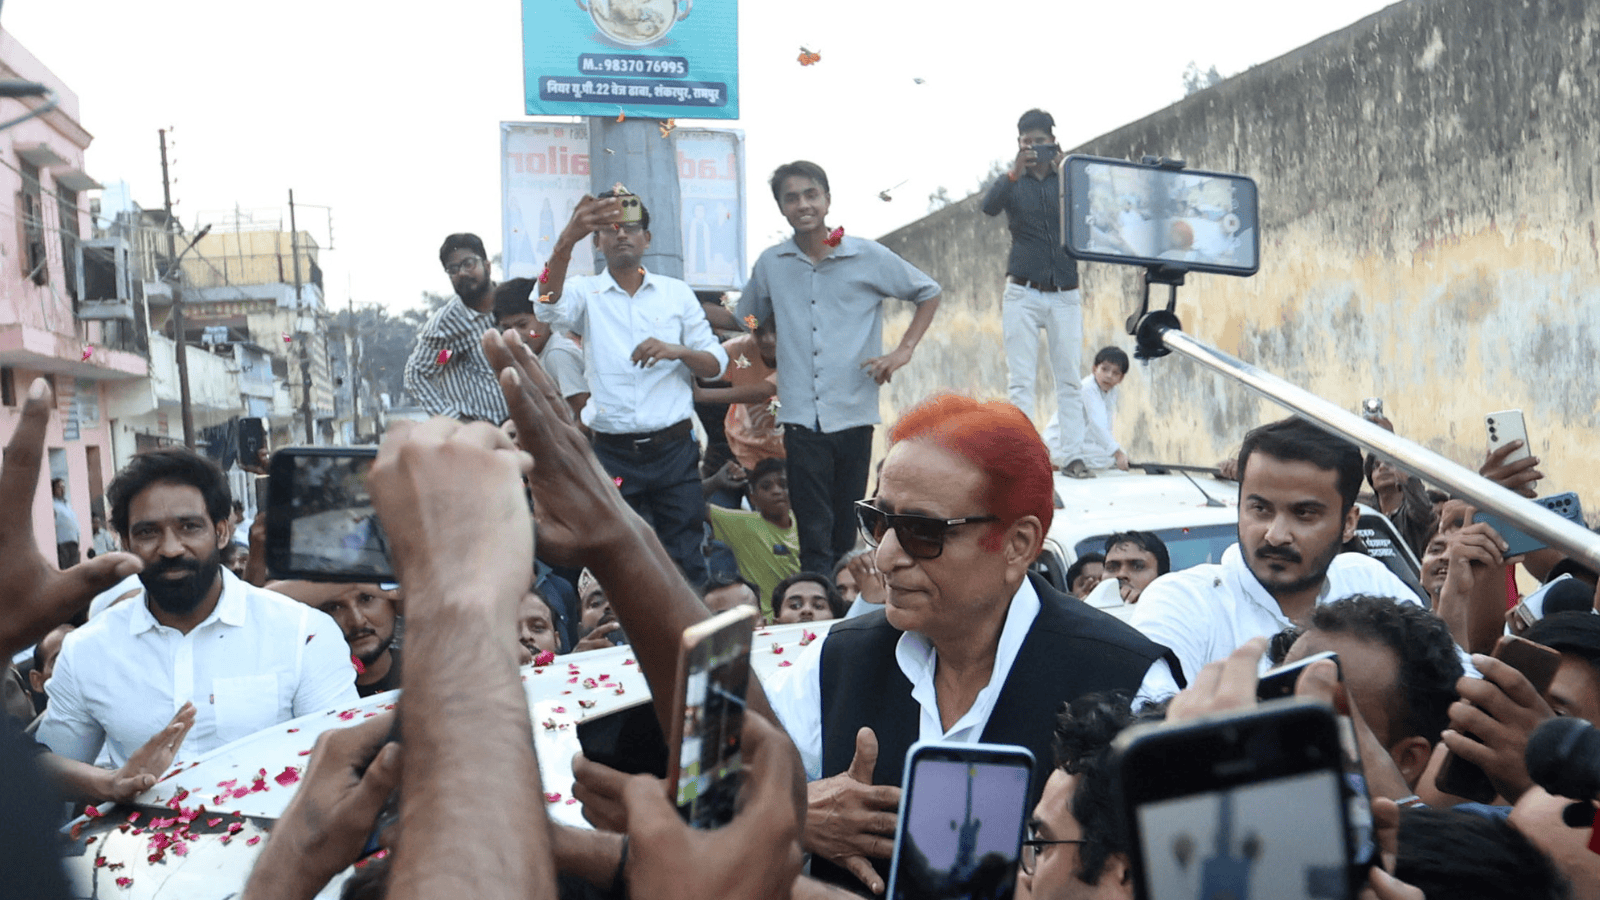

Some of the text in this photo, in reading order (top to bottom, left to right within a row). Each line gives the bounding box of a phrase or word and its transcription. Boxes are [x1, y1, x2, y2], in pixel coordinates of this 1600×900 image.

[645, 60, 685, 74] 76995
[546, 79, 570, 94] नियर
[692, 87, 720, 103] रामपुर
